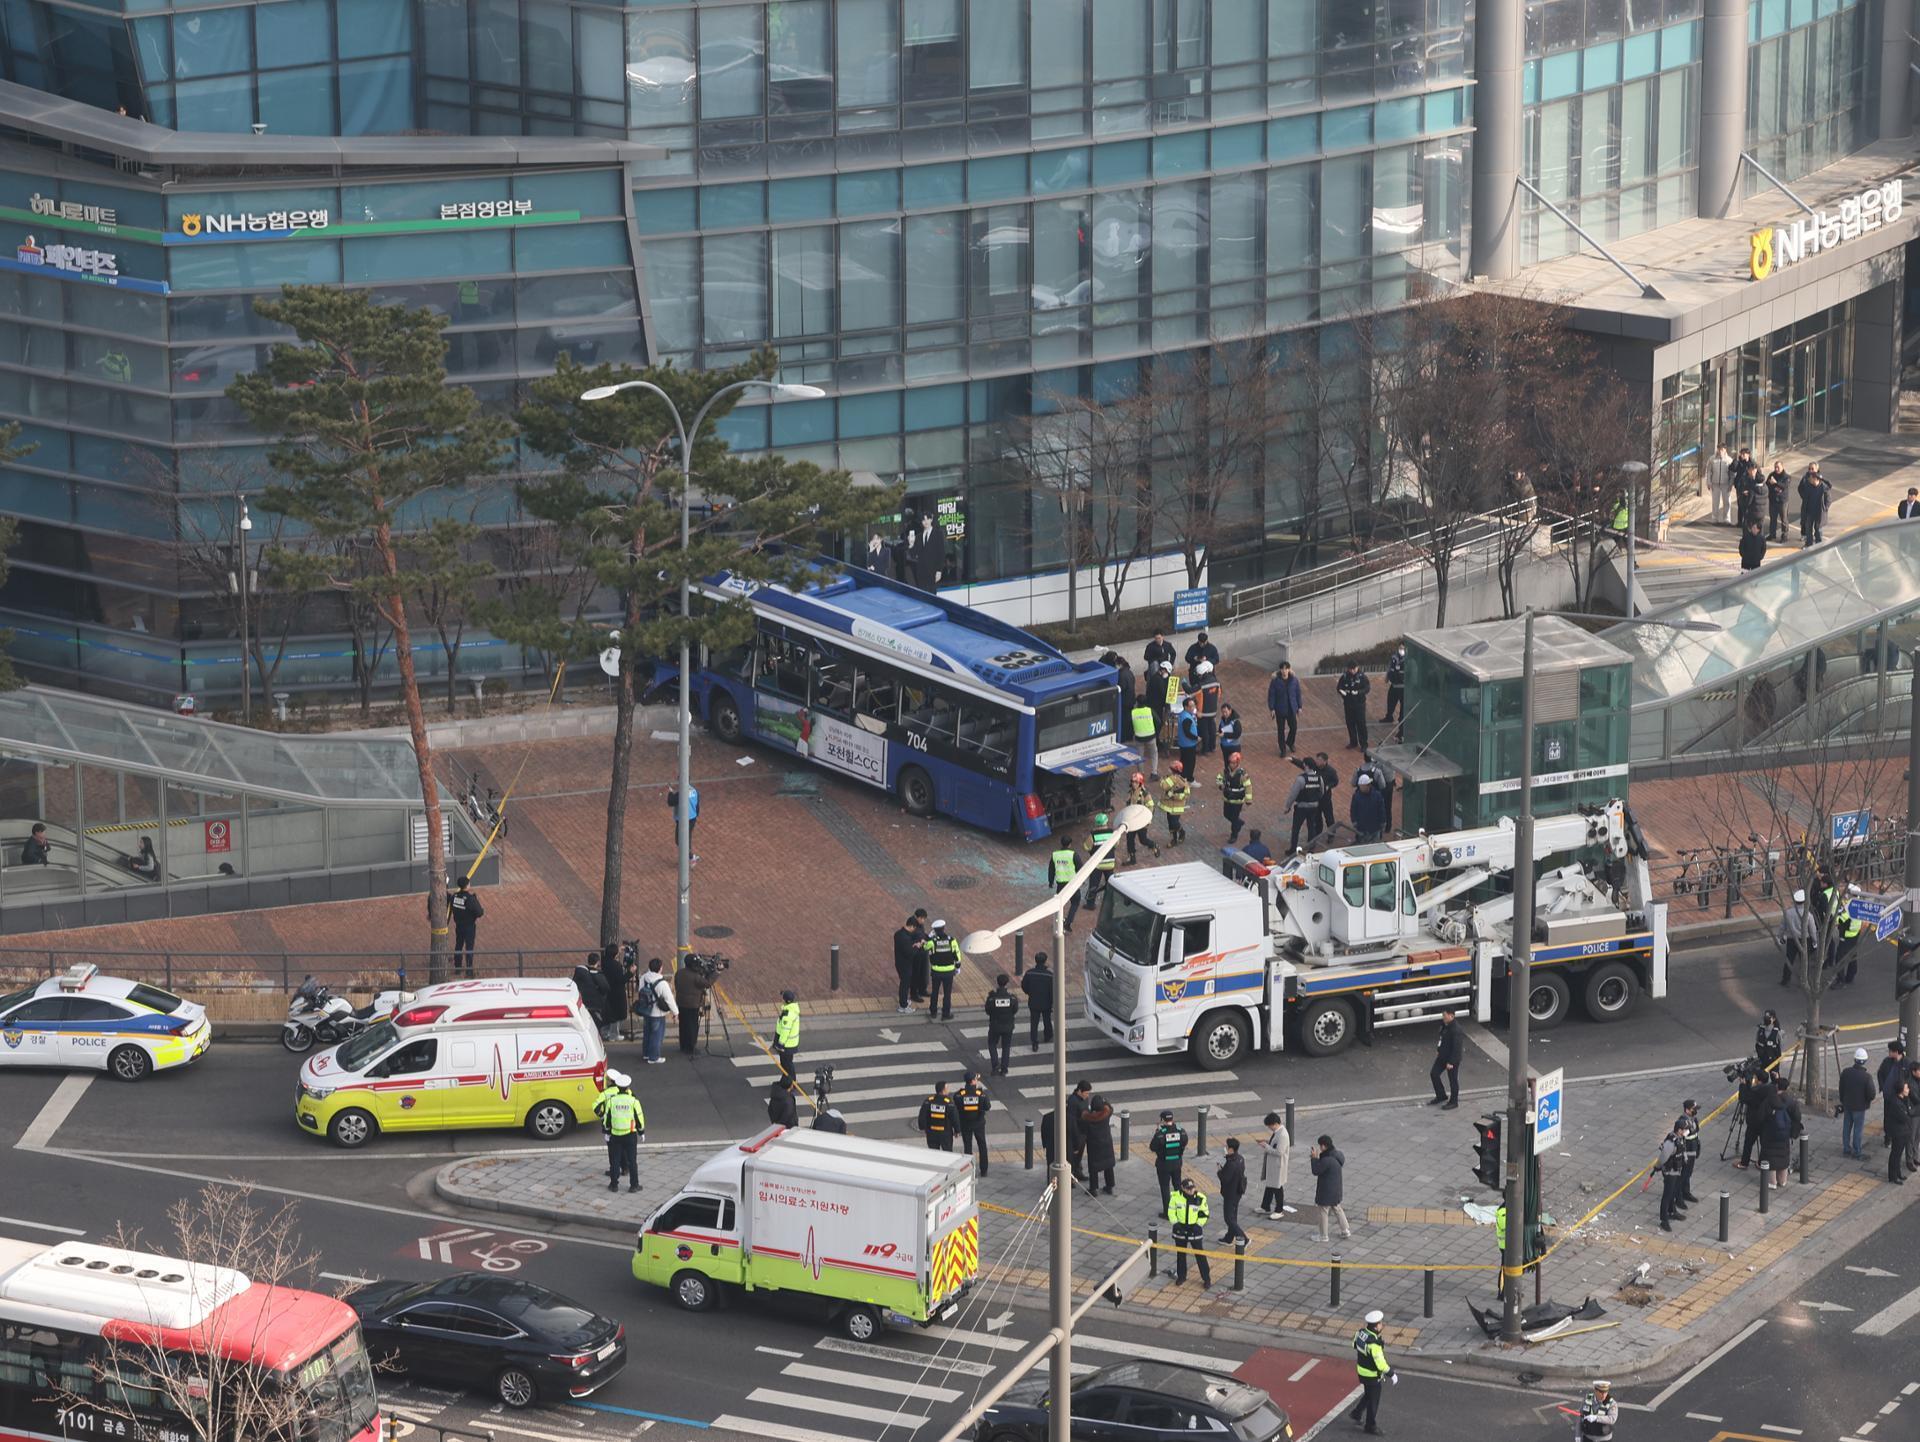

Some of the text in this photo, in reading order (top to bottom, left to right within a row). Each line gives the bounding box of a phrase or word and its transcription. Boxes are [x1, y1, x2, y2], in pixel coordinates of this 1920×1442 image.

[29, 192, 117, 226] 하나로마트
[440, 199, 533, 220] 본점영업부
[205, 208, 329, 233] NH농협은행
[1775, 179, 1903, 268] NH농협은행
[45, 244, 118, 275] 페인터즈
[938, 501, 957, 514] 매일
[946, 523, 965, 536] 만남
[1090, 720, 1107, 735] 704
[907, 730, 928, 752] 704
[827, 743, 879, 772] 포천힐스CC
[1453, 844, 1476, 860] 경찰
[1582, 942, 1609, 955] POLICE
[72, 1037, 107, 1047] POLICE
[520, 1042, 564, 1064] 119
[524, 1070, 561, 1079] AMBULANCE
[758, 1191, 850, 1216] 임시의료소 지원차량
[863, 1243, 897, 1258] 119
[57, 1408, 94, 1431] 7101
[103, 1418, 126, 1436] 금촌
